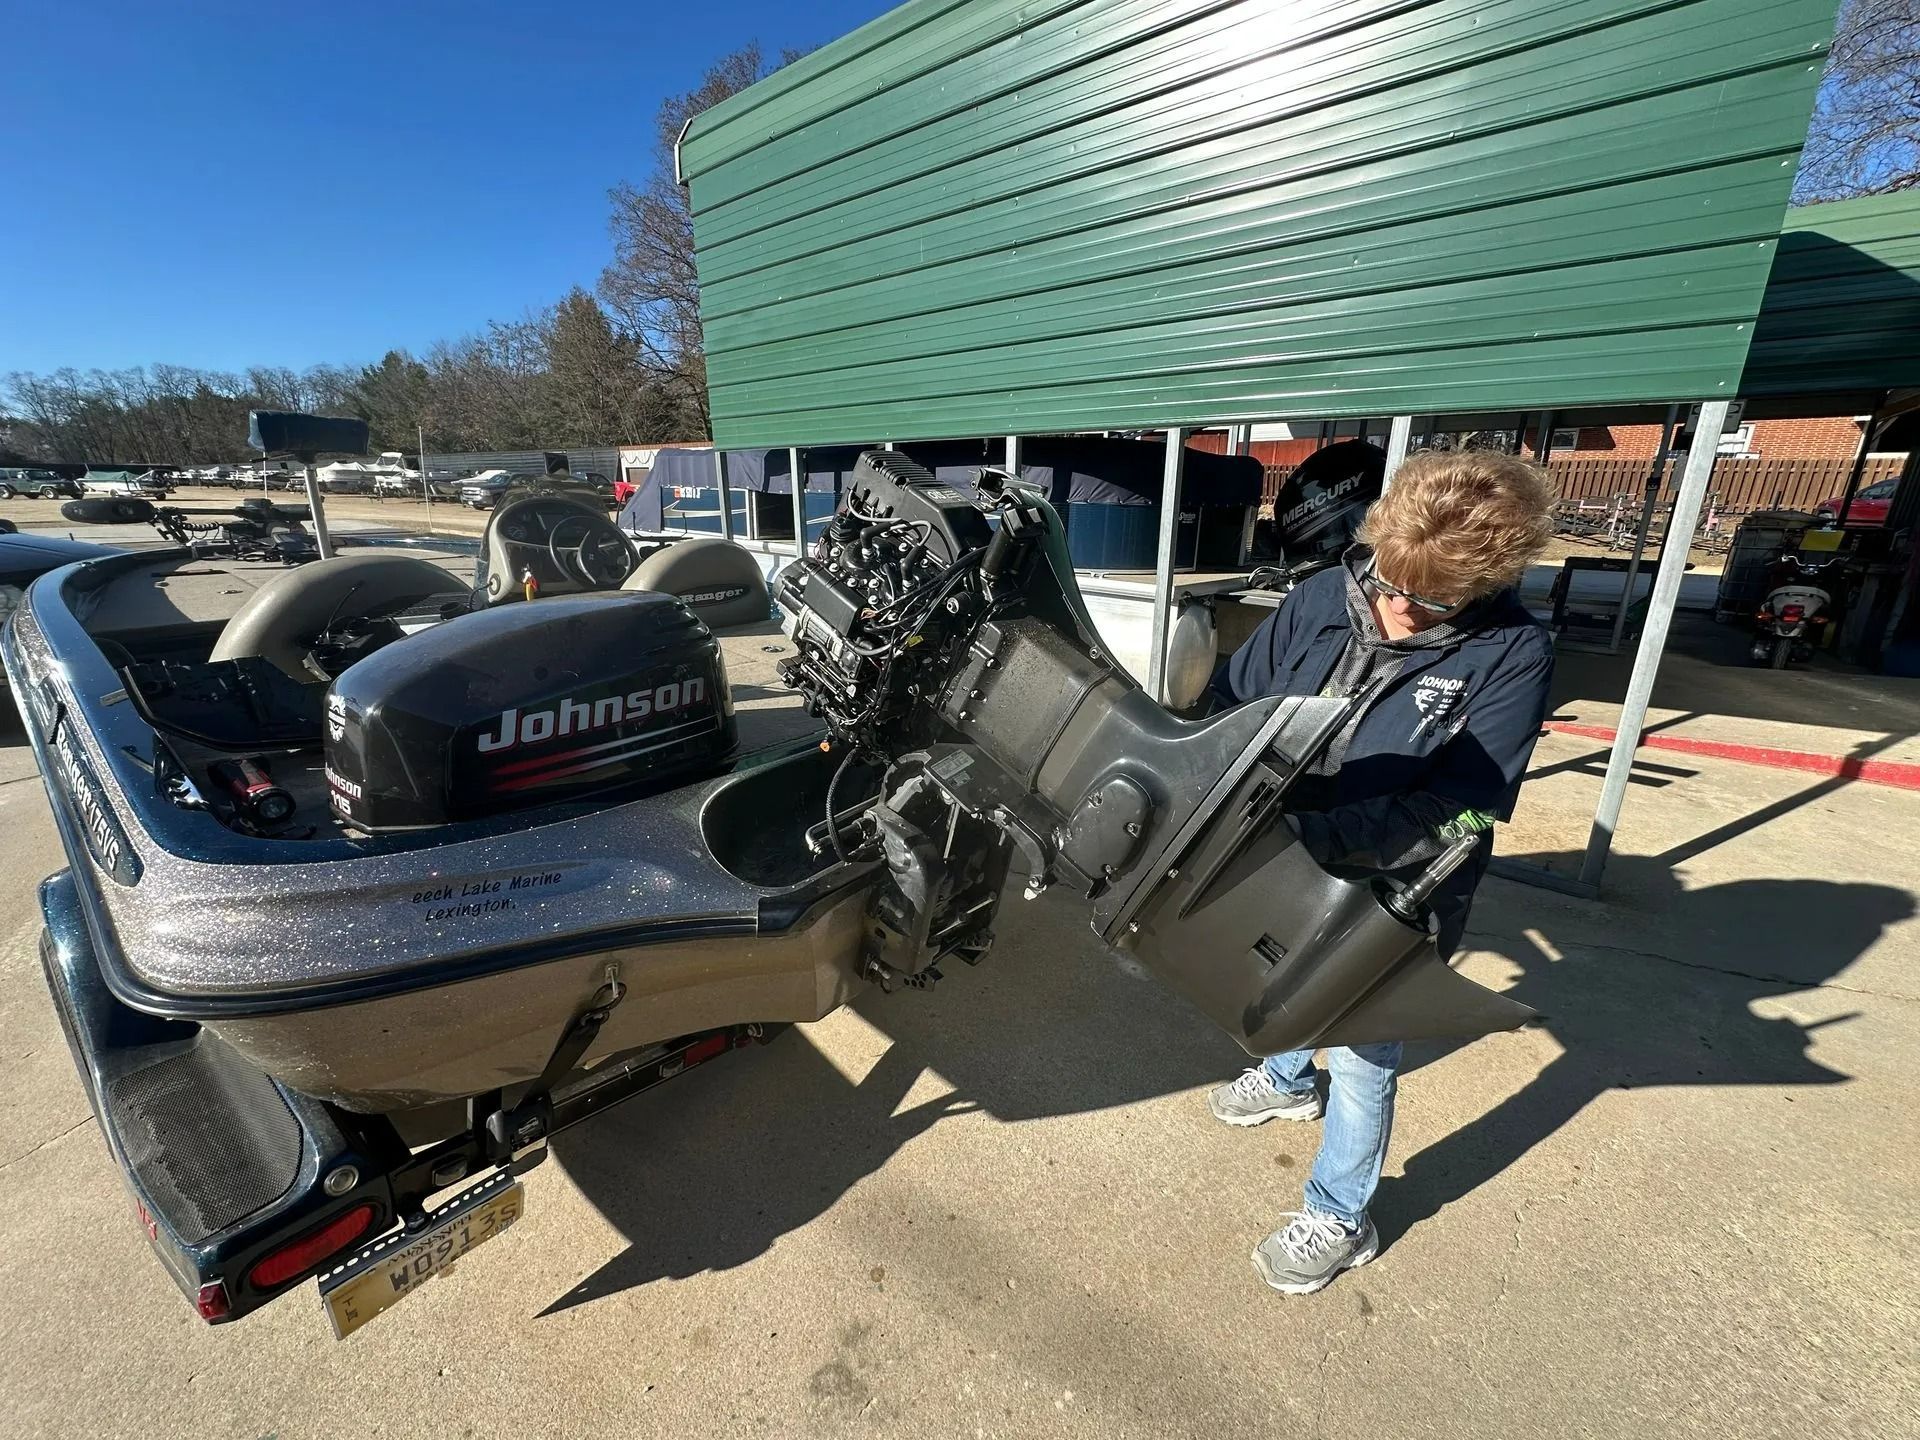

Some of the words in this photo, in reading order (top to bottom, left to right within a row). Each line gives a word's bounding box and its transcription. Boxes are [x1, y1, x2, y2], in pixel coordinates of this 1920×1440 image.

[1282, 472, 1364, 527] MERCURY
[679, 588, 744, 603] Ranger
[477, 677, 705, 752] Johnson
[461, 879, 502, 897] Lake
[509, 871, 562, 890] Marine
